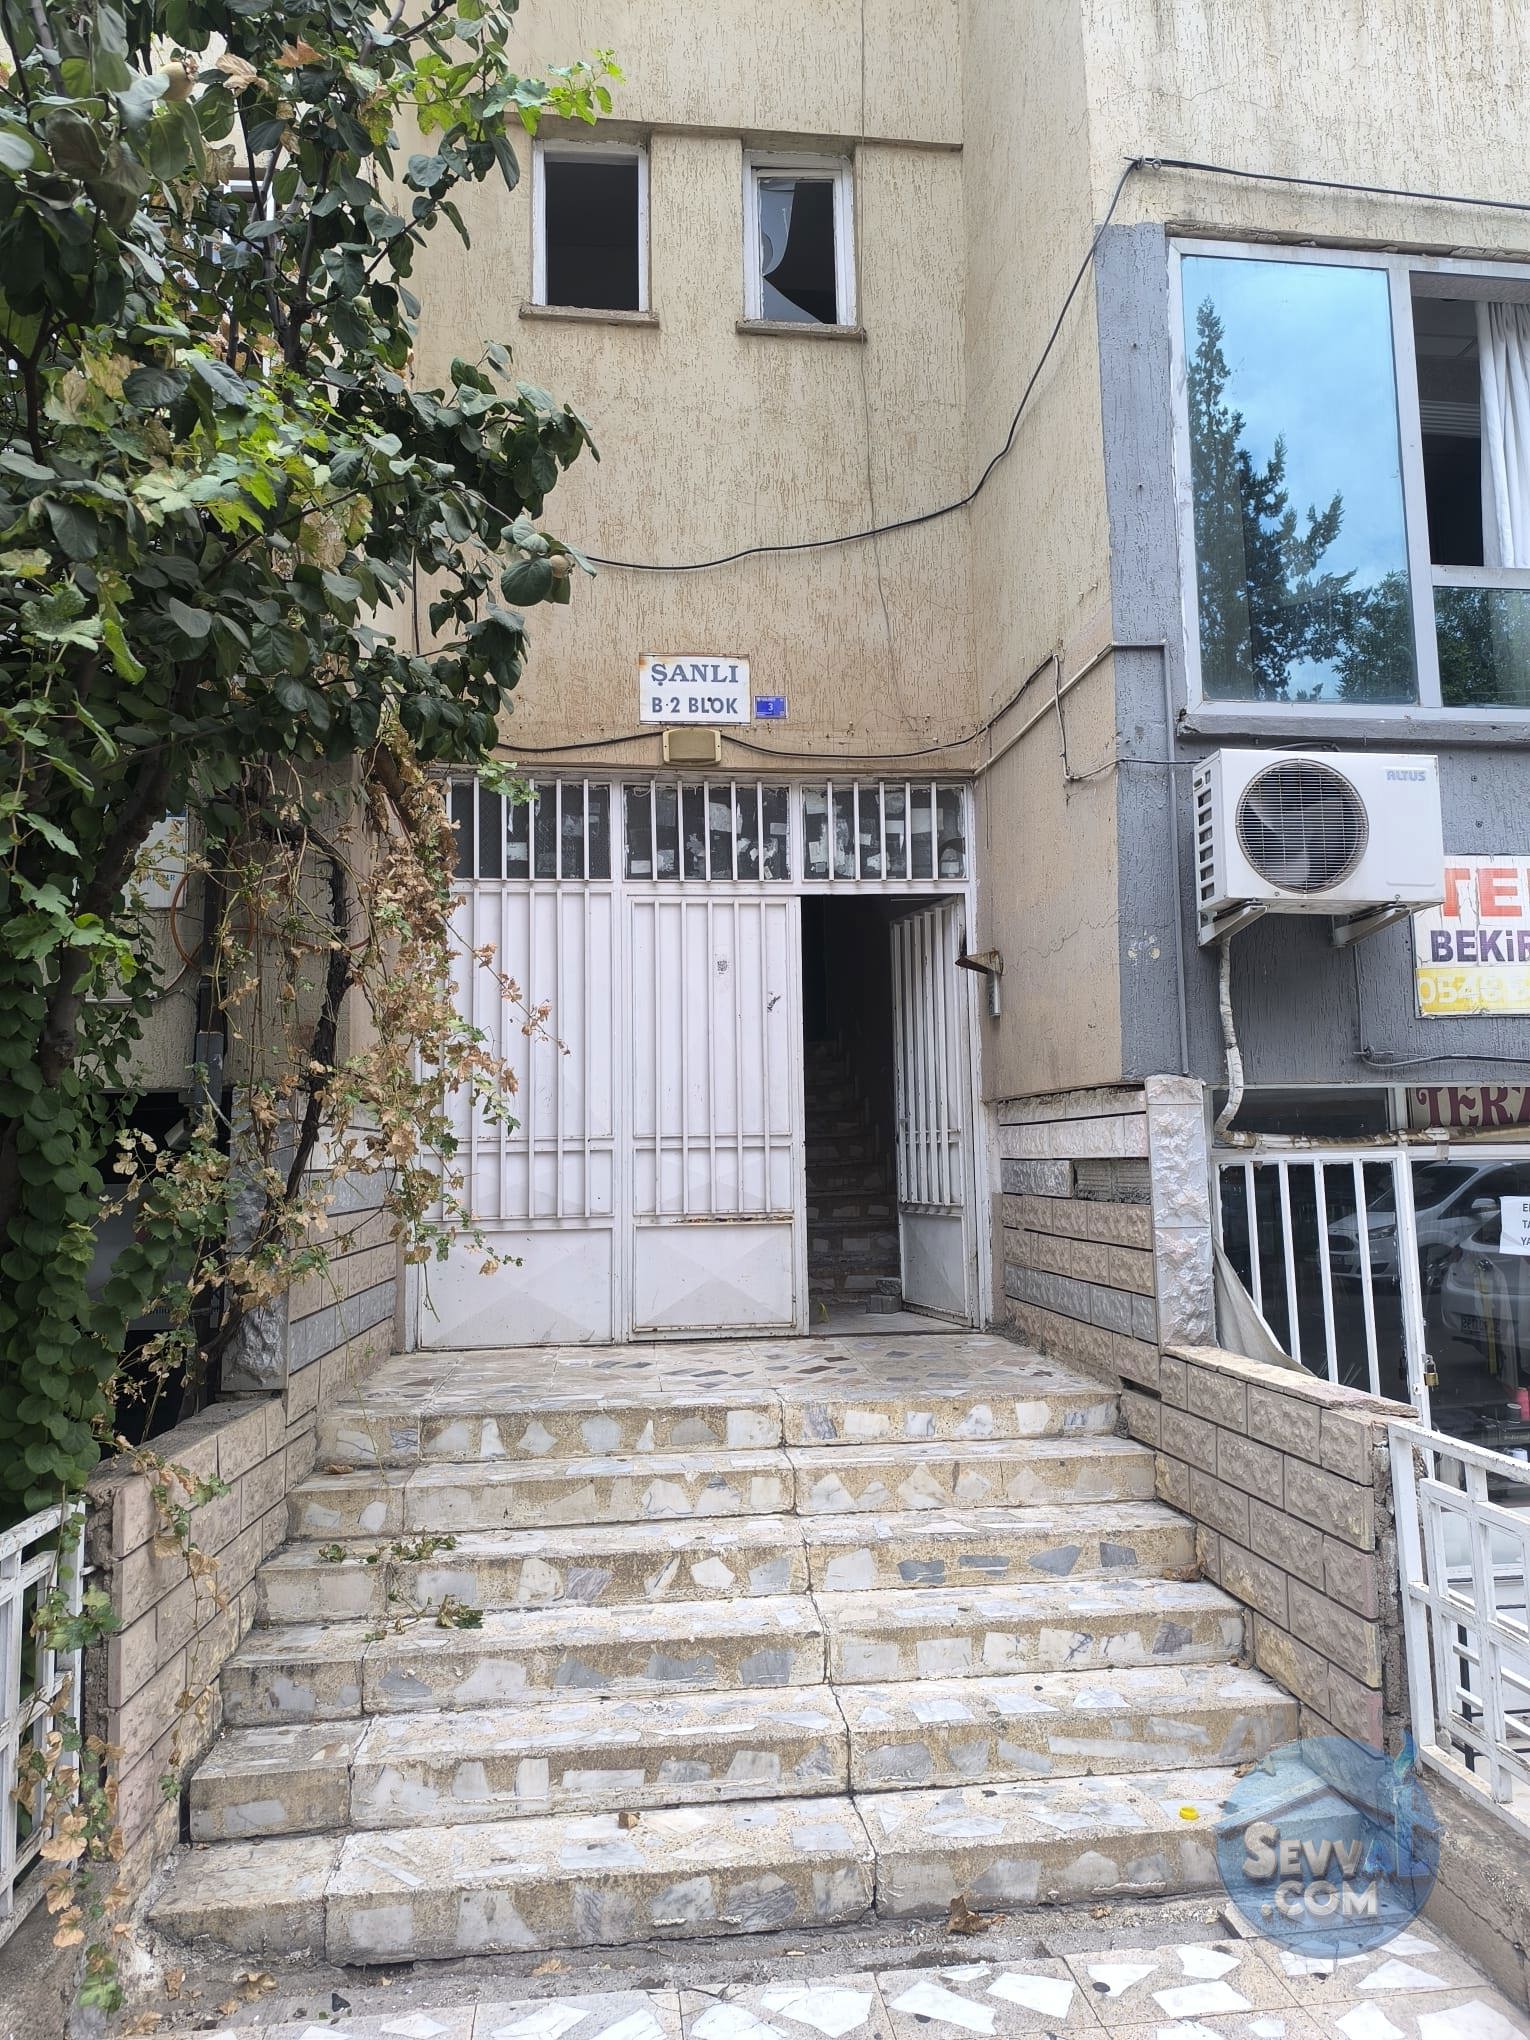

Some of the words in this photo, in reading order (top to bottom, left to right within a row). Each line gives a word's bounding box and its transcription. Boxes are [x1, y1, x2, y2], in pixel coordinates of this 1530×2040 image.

[651, 663, 739, 687] ŞANLI
[688, 697, 738, 714] BLOK
[1443, 868, 1530, 917] TE
